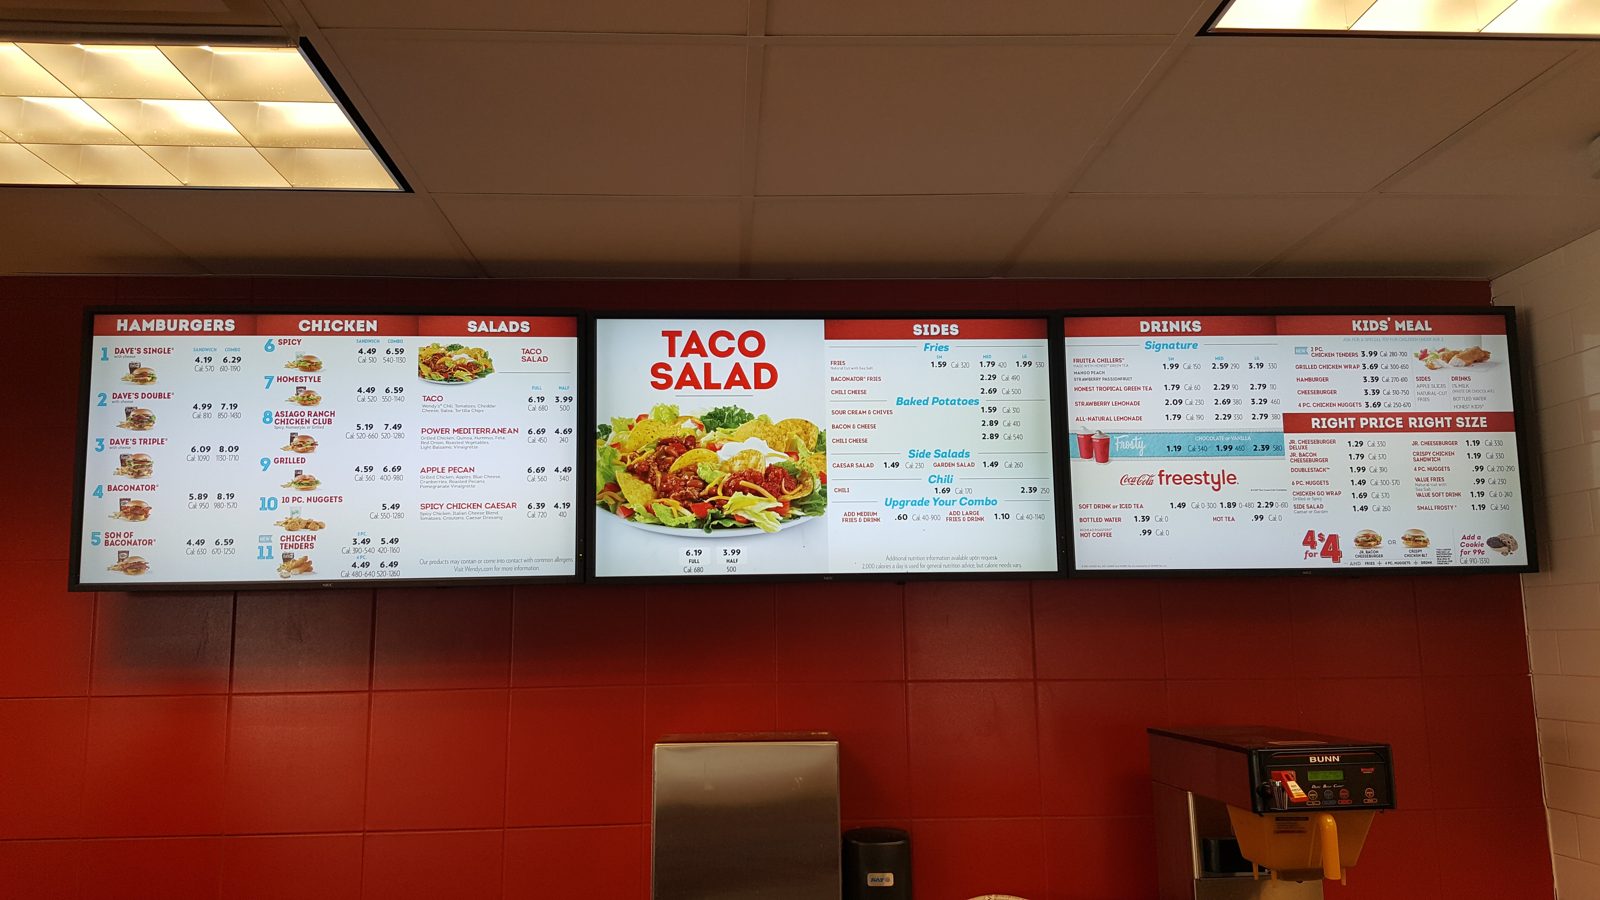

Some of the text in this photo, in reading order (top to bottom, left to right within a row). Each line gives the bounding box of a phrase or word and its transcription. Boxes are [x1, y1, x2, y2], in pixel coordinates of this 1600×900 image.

[117, 319, 235, 331] HAMBURGERS
[298, 320, 377, 332] CHICKEN
[467, 320, 530, 332] SALADS
[913, 324, 959, 335] SIDES
[1140, 320, 1201, 332] DRINKS
[1352, 317, 1432, 331] KIDS' MEAL
[264, 339, 275, 352] 6
[661, 330, 766, 358] TACO
[924, 343, 949, 352] Fries
[1145, 341, 1198, 352] Signature
[101, 347, 109, 361] 1
[650, 362, 778, 390] SALAD
[264, 376, 274, 389] 7
[97, 393, 107, 407] 2
[896, 397, 979, 406] Baked Potatoes
[262, 410, 273, 424] 8
[1311, 417, 1487, 428] RIGHT PRICE RIGHT SIZE
[95, 438, 105, 452] 3
[219, 445, 239, 453] 8.09
[1114, 435, 1146, 456] Frosty
[908, 449, 970, 458] Side Salads
[260, 457, 271, 472] 9
[928, 474, 954, 484] Chili
[93, 485, 104, 499] 4
[259, 497, 278, 511] 10
[527, 502, 545, 510] 6.39
[885, 497, 998, 509] Upgrade Your Combo
[91, 532, 101, 546] 5
[215, 538, 234, 546] 6.59
[381, 537, 399, 545] 5.49
[1460, 540, 1484, 549] Cookie
[280, 542, 314, 550] TENDERS
[257, 545, 274, 560] 11
[1304, 550, 1318, 560] for
